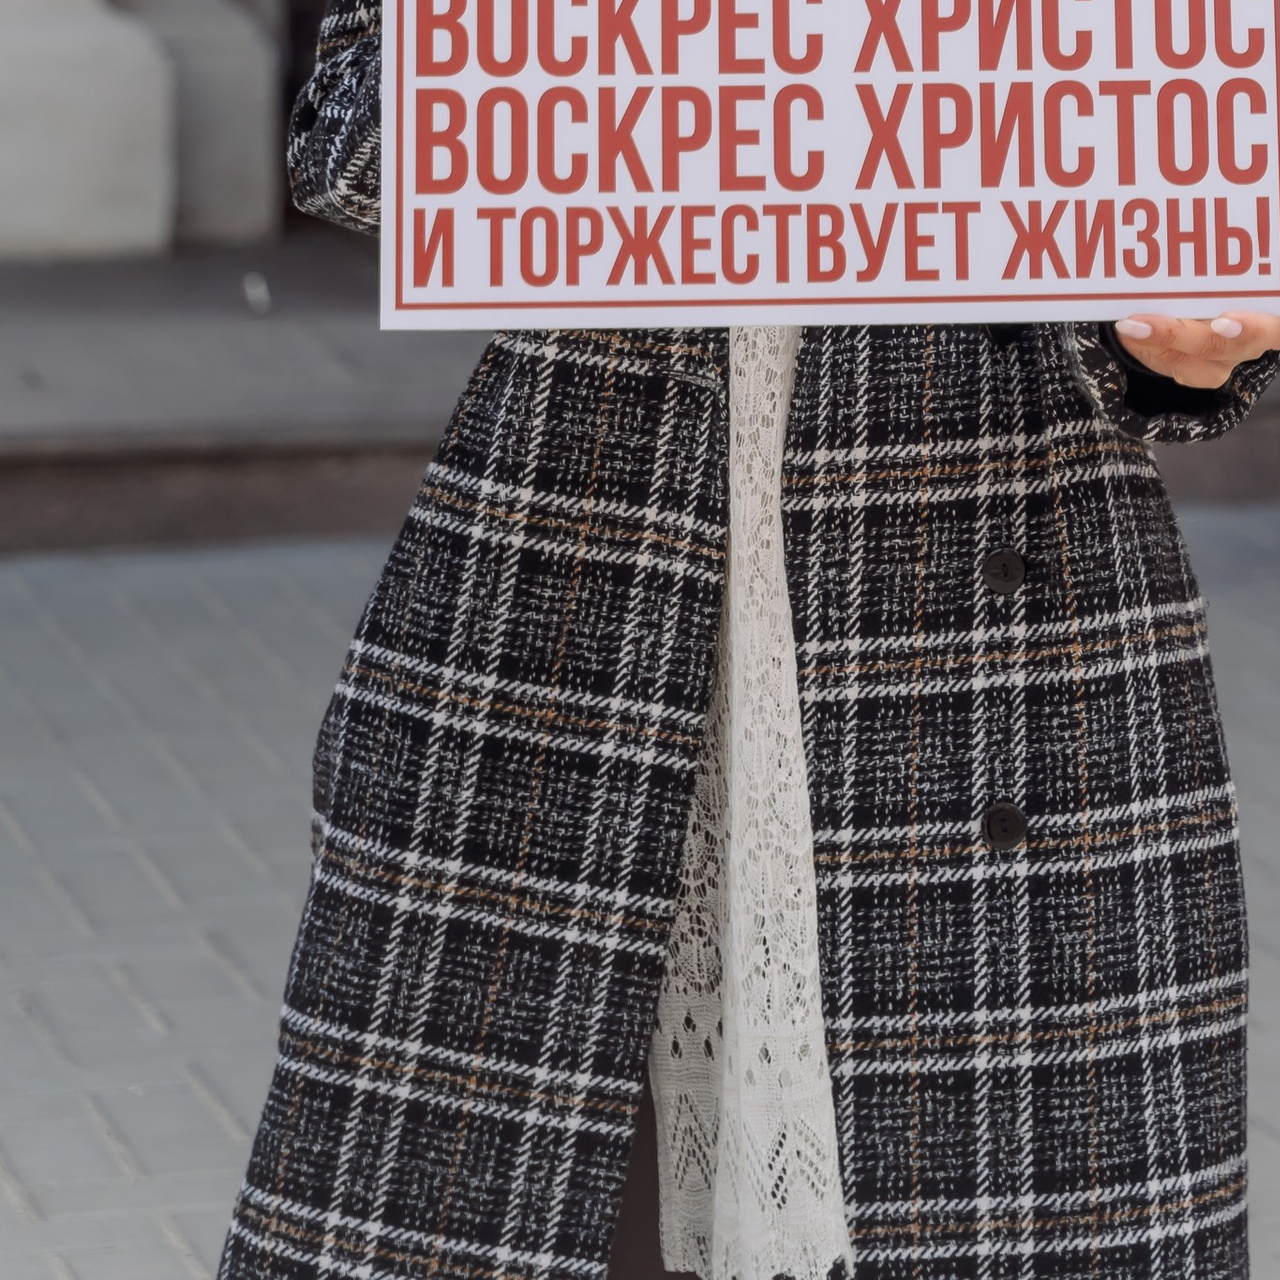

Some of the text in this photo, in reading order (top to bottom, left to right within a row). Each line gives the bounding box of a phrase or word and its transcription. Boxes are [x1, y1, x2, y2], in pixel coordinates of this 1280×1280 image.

[416, 79, 1268, 195] ВОСКРЕС ХРИСТОС
[413, 196, 1272, 289] И ТОРЖЕСТВУЕТ ЖИЗНЬ!
